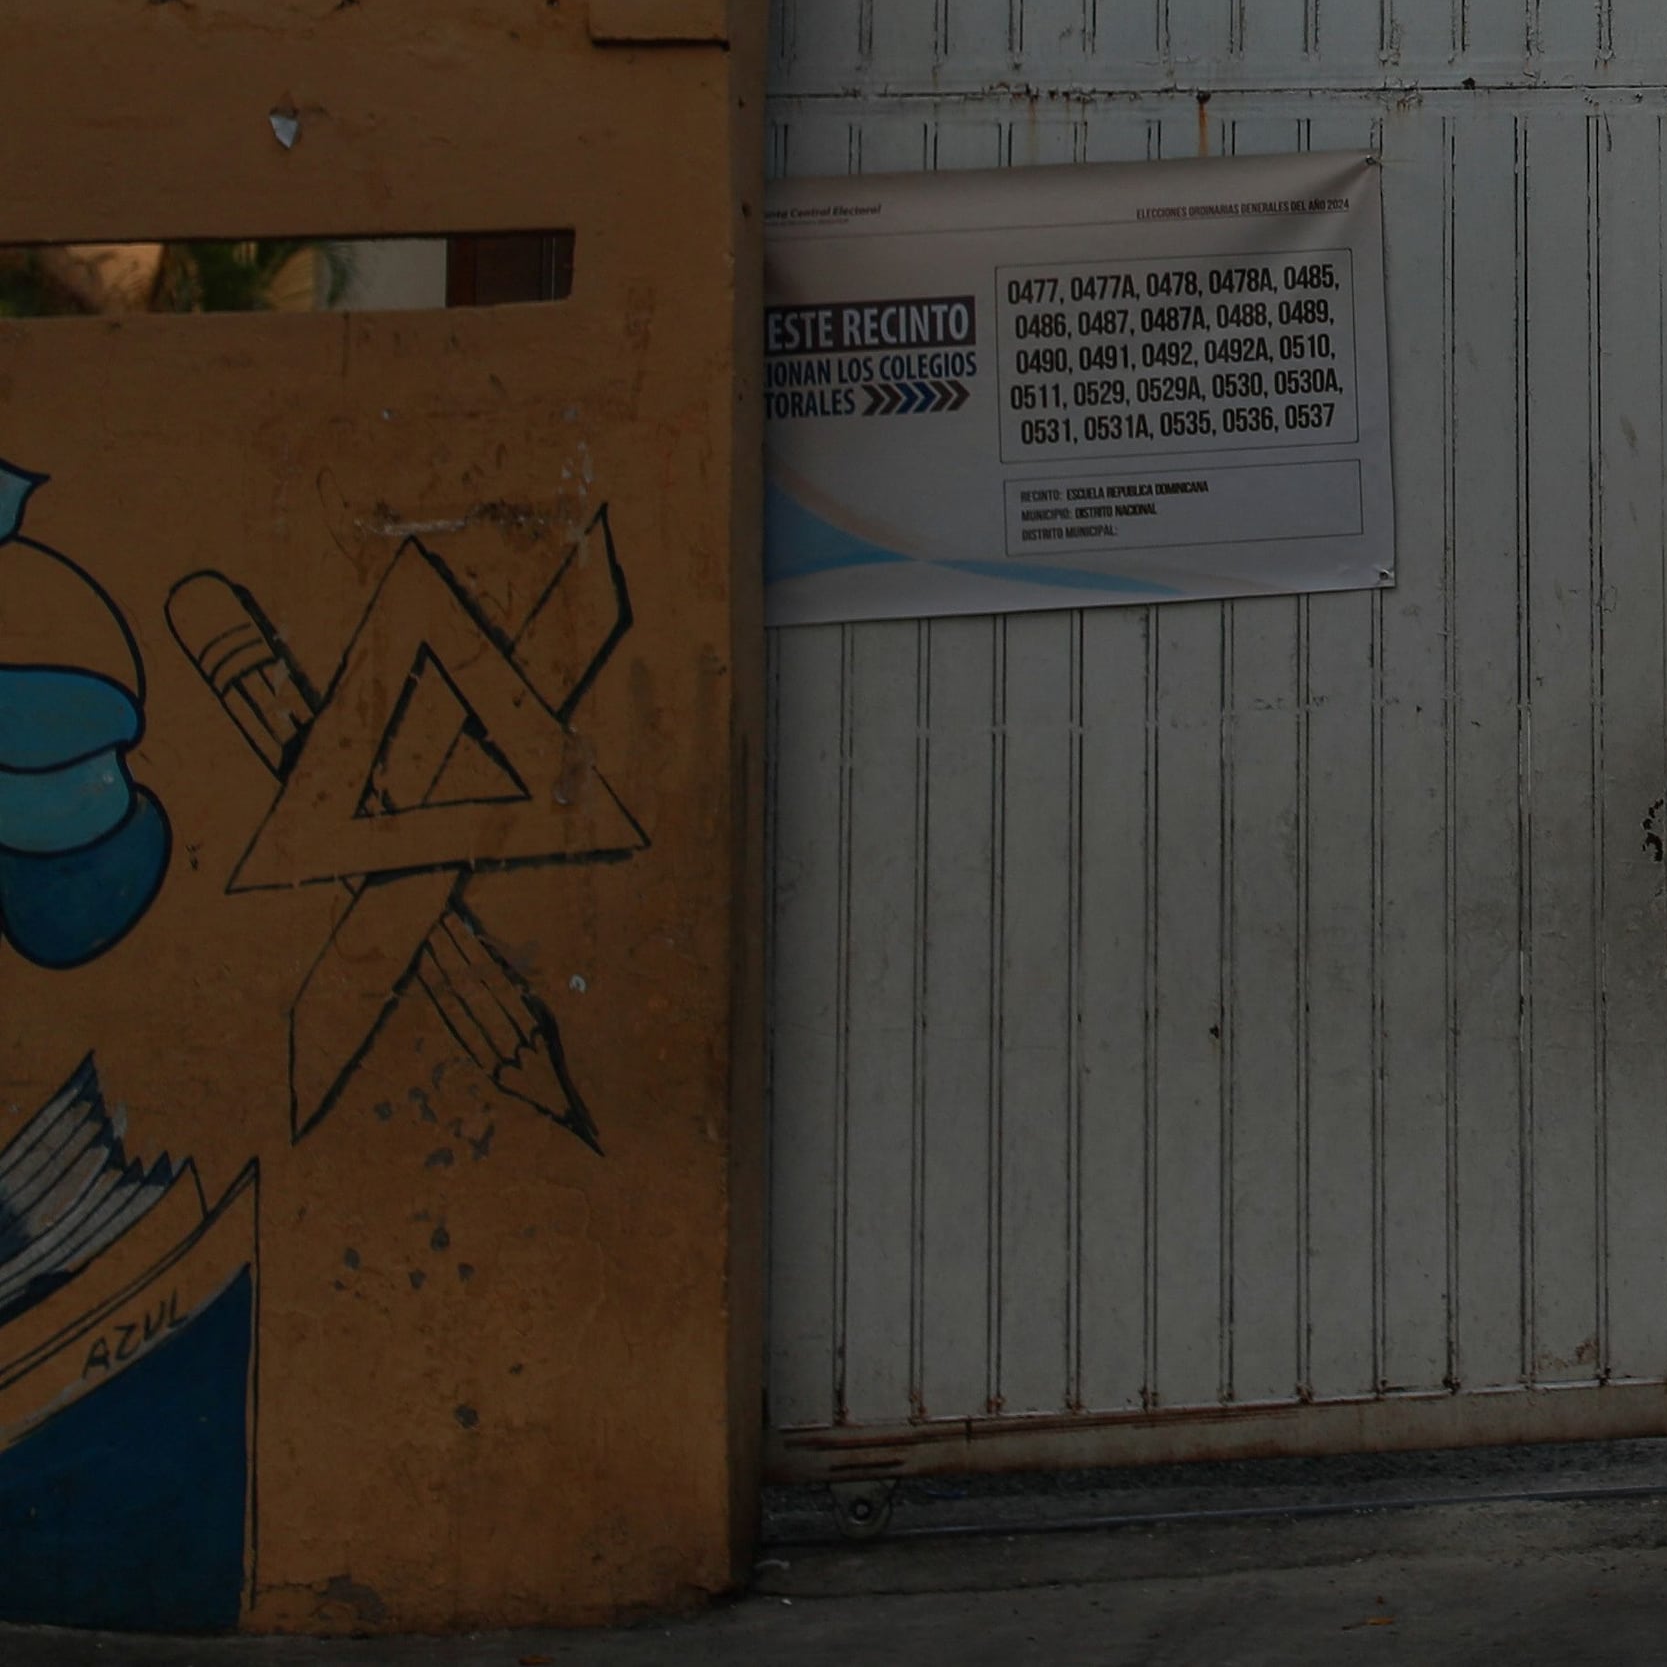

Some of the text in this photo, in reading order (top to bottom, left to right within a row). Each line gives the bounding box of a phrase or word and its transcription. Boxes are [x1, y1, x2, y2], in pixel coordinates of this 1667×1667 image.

[1290, 201, 1306, 213] DEL
[1307, 199, 1326, 211] AÑO
[1327, 198, 1349, 211] 2024
[1008, 264, 1339, 304] 0477, 0477A, 0478, 0478A, 0485,
[769, 303, 969, 349] ESTE RECINTO
[1015, 300, 1334, 339] 0486, 0487, 0487A, 0488, 0489,
[765, 352, 977, 387] IONAN LOS COLEGIOS
[1016, 335, 1335, 374] 0490, 0491, 0492, 0492A, 0510,
[1011, 369, 1343, 410] 0511, 0529, 0529A, 0530, 0530A,
[1022, 404, 1334, 444] 0531, 0531A, 0535, 0536, 0537
[82, 1289, 188, 1380] AZUL
